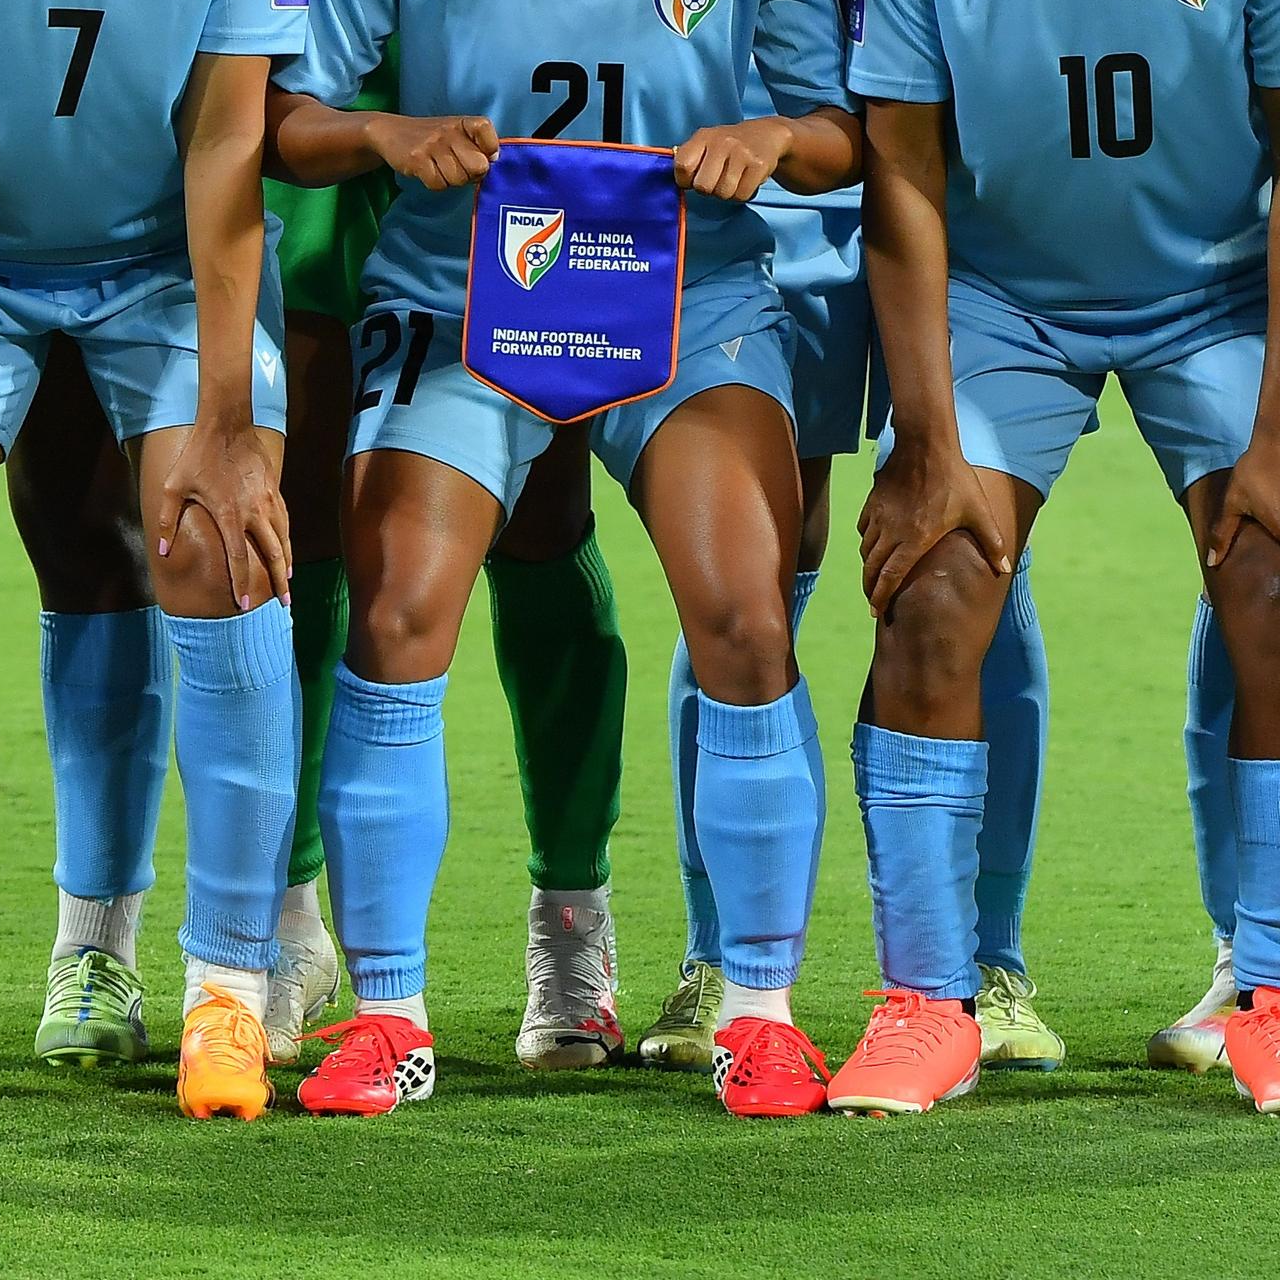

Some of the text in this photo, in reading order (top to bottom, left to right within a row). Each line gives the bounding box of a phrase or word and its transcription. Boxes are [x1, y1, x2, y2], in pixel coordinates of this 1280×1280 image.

[47, 8, 106, 118] 7
[531, 60, 625, 144] 21
[1059, 52, 1154, 160] 10
[510, 214, 544, 227] INDIA
[570, 232, 634, 245] ALL INDIA
[570, 245, 636, 258] FOOTBALL
[569, 259, 649, 272] FEDERATION
[493, 328, 610, 345] INDIAN FOOTBALL
[492, 342, 641, 360] FORWARD TOGETHER
[353, 310, 434, 417] 21
